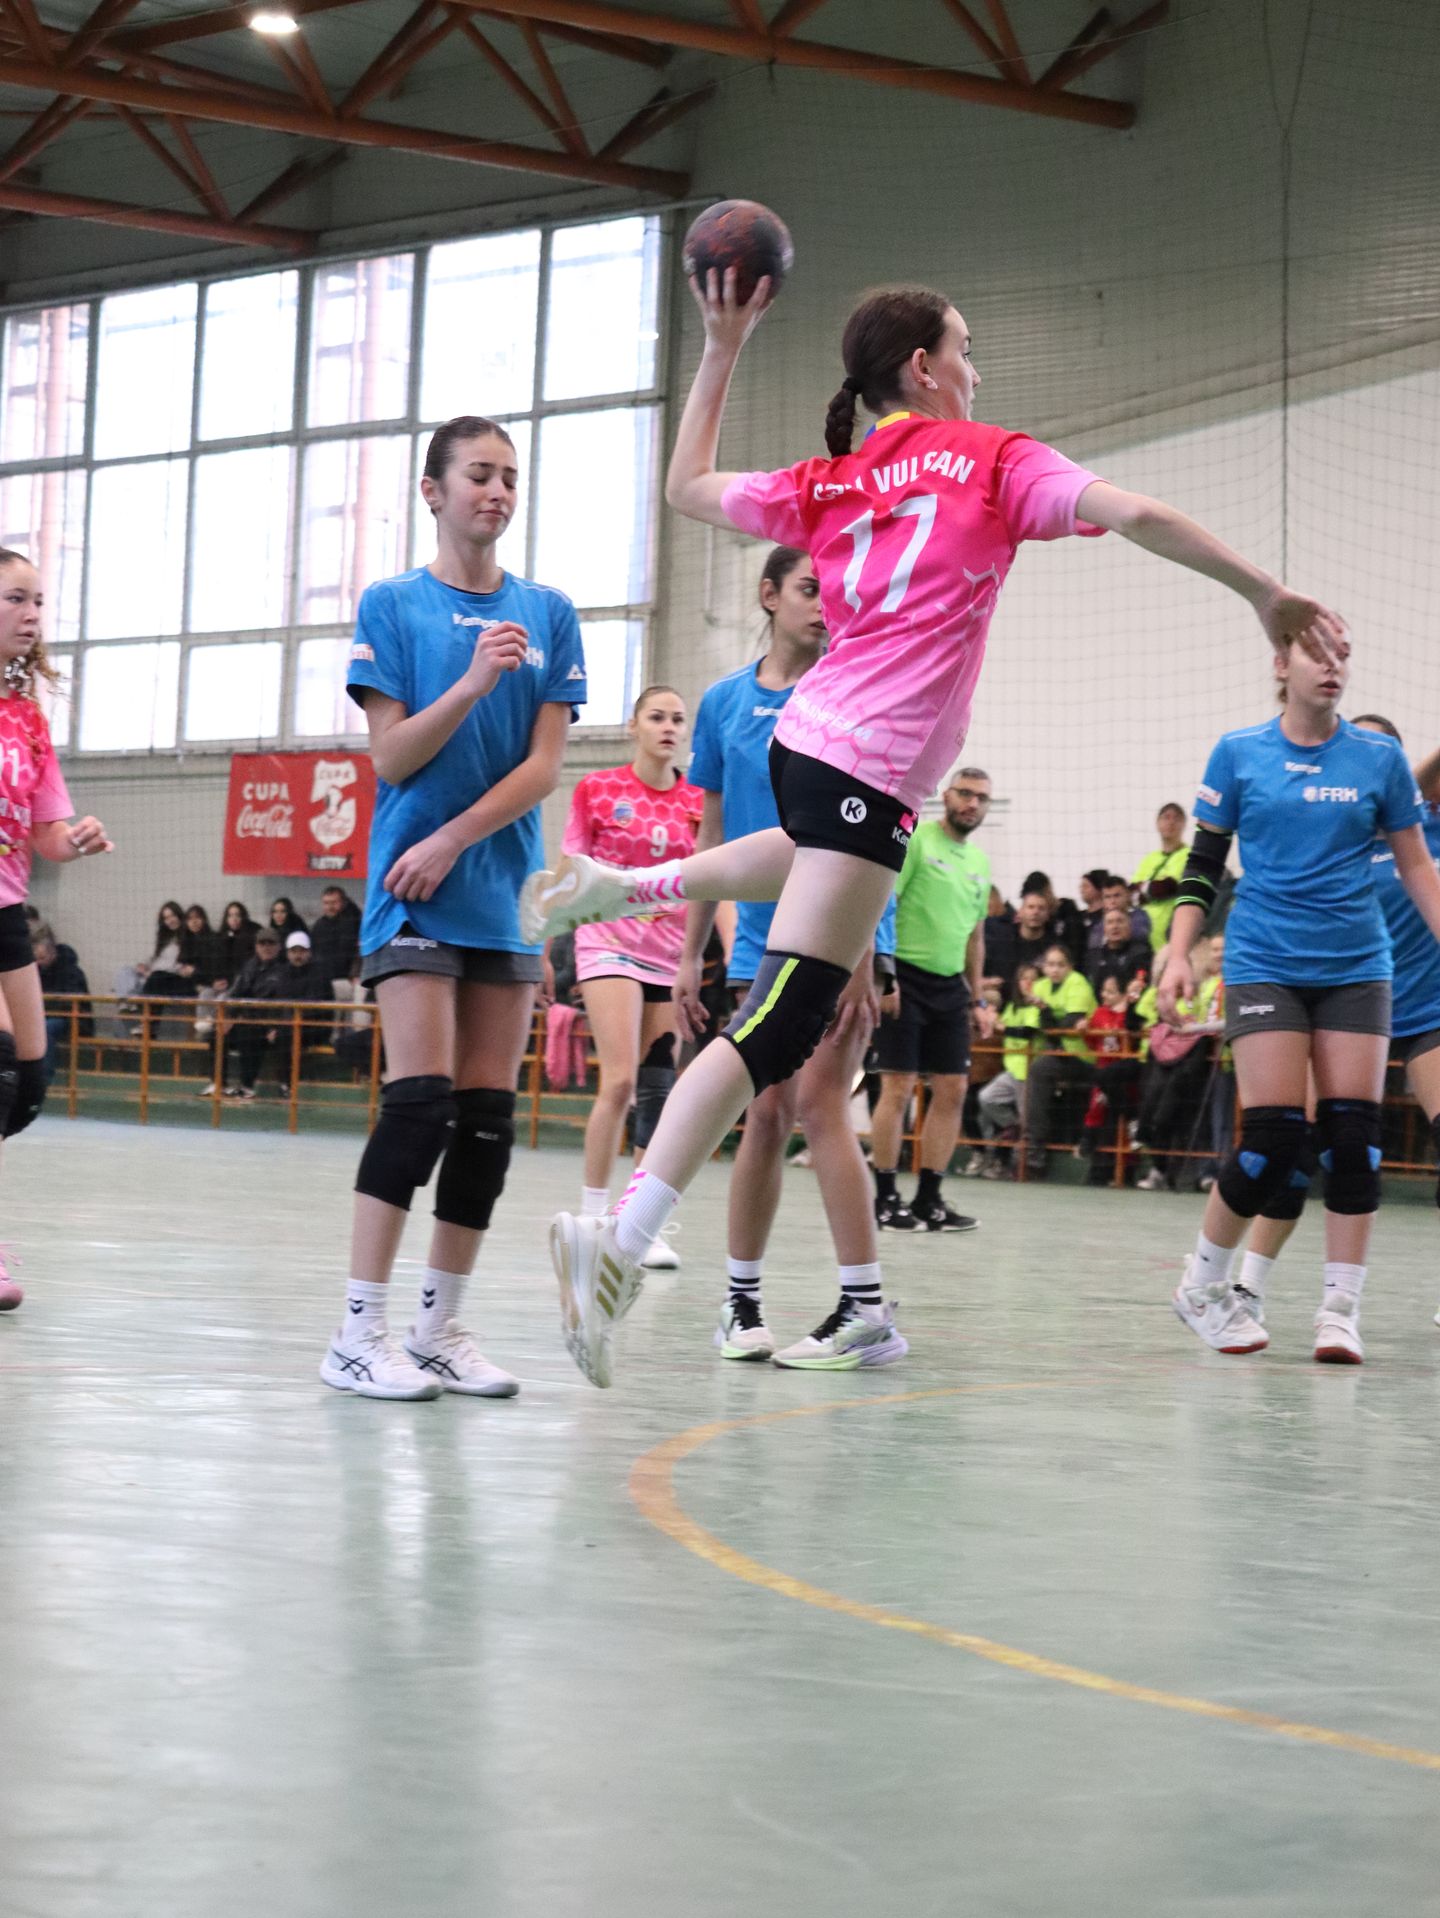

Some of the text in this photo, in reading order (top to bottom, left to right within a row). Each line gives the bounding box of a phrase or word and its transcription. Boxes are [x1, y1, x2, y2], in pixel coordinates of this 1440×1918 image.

[840, 494, 938, 613] 17
[242, 782, 289, 801] CUPA
[650, 825, 668, 858] 9
